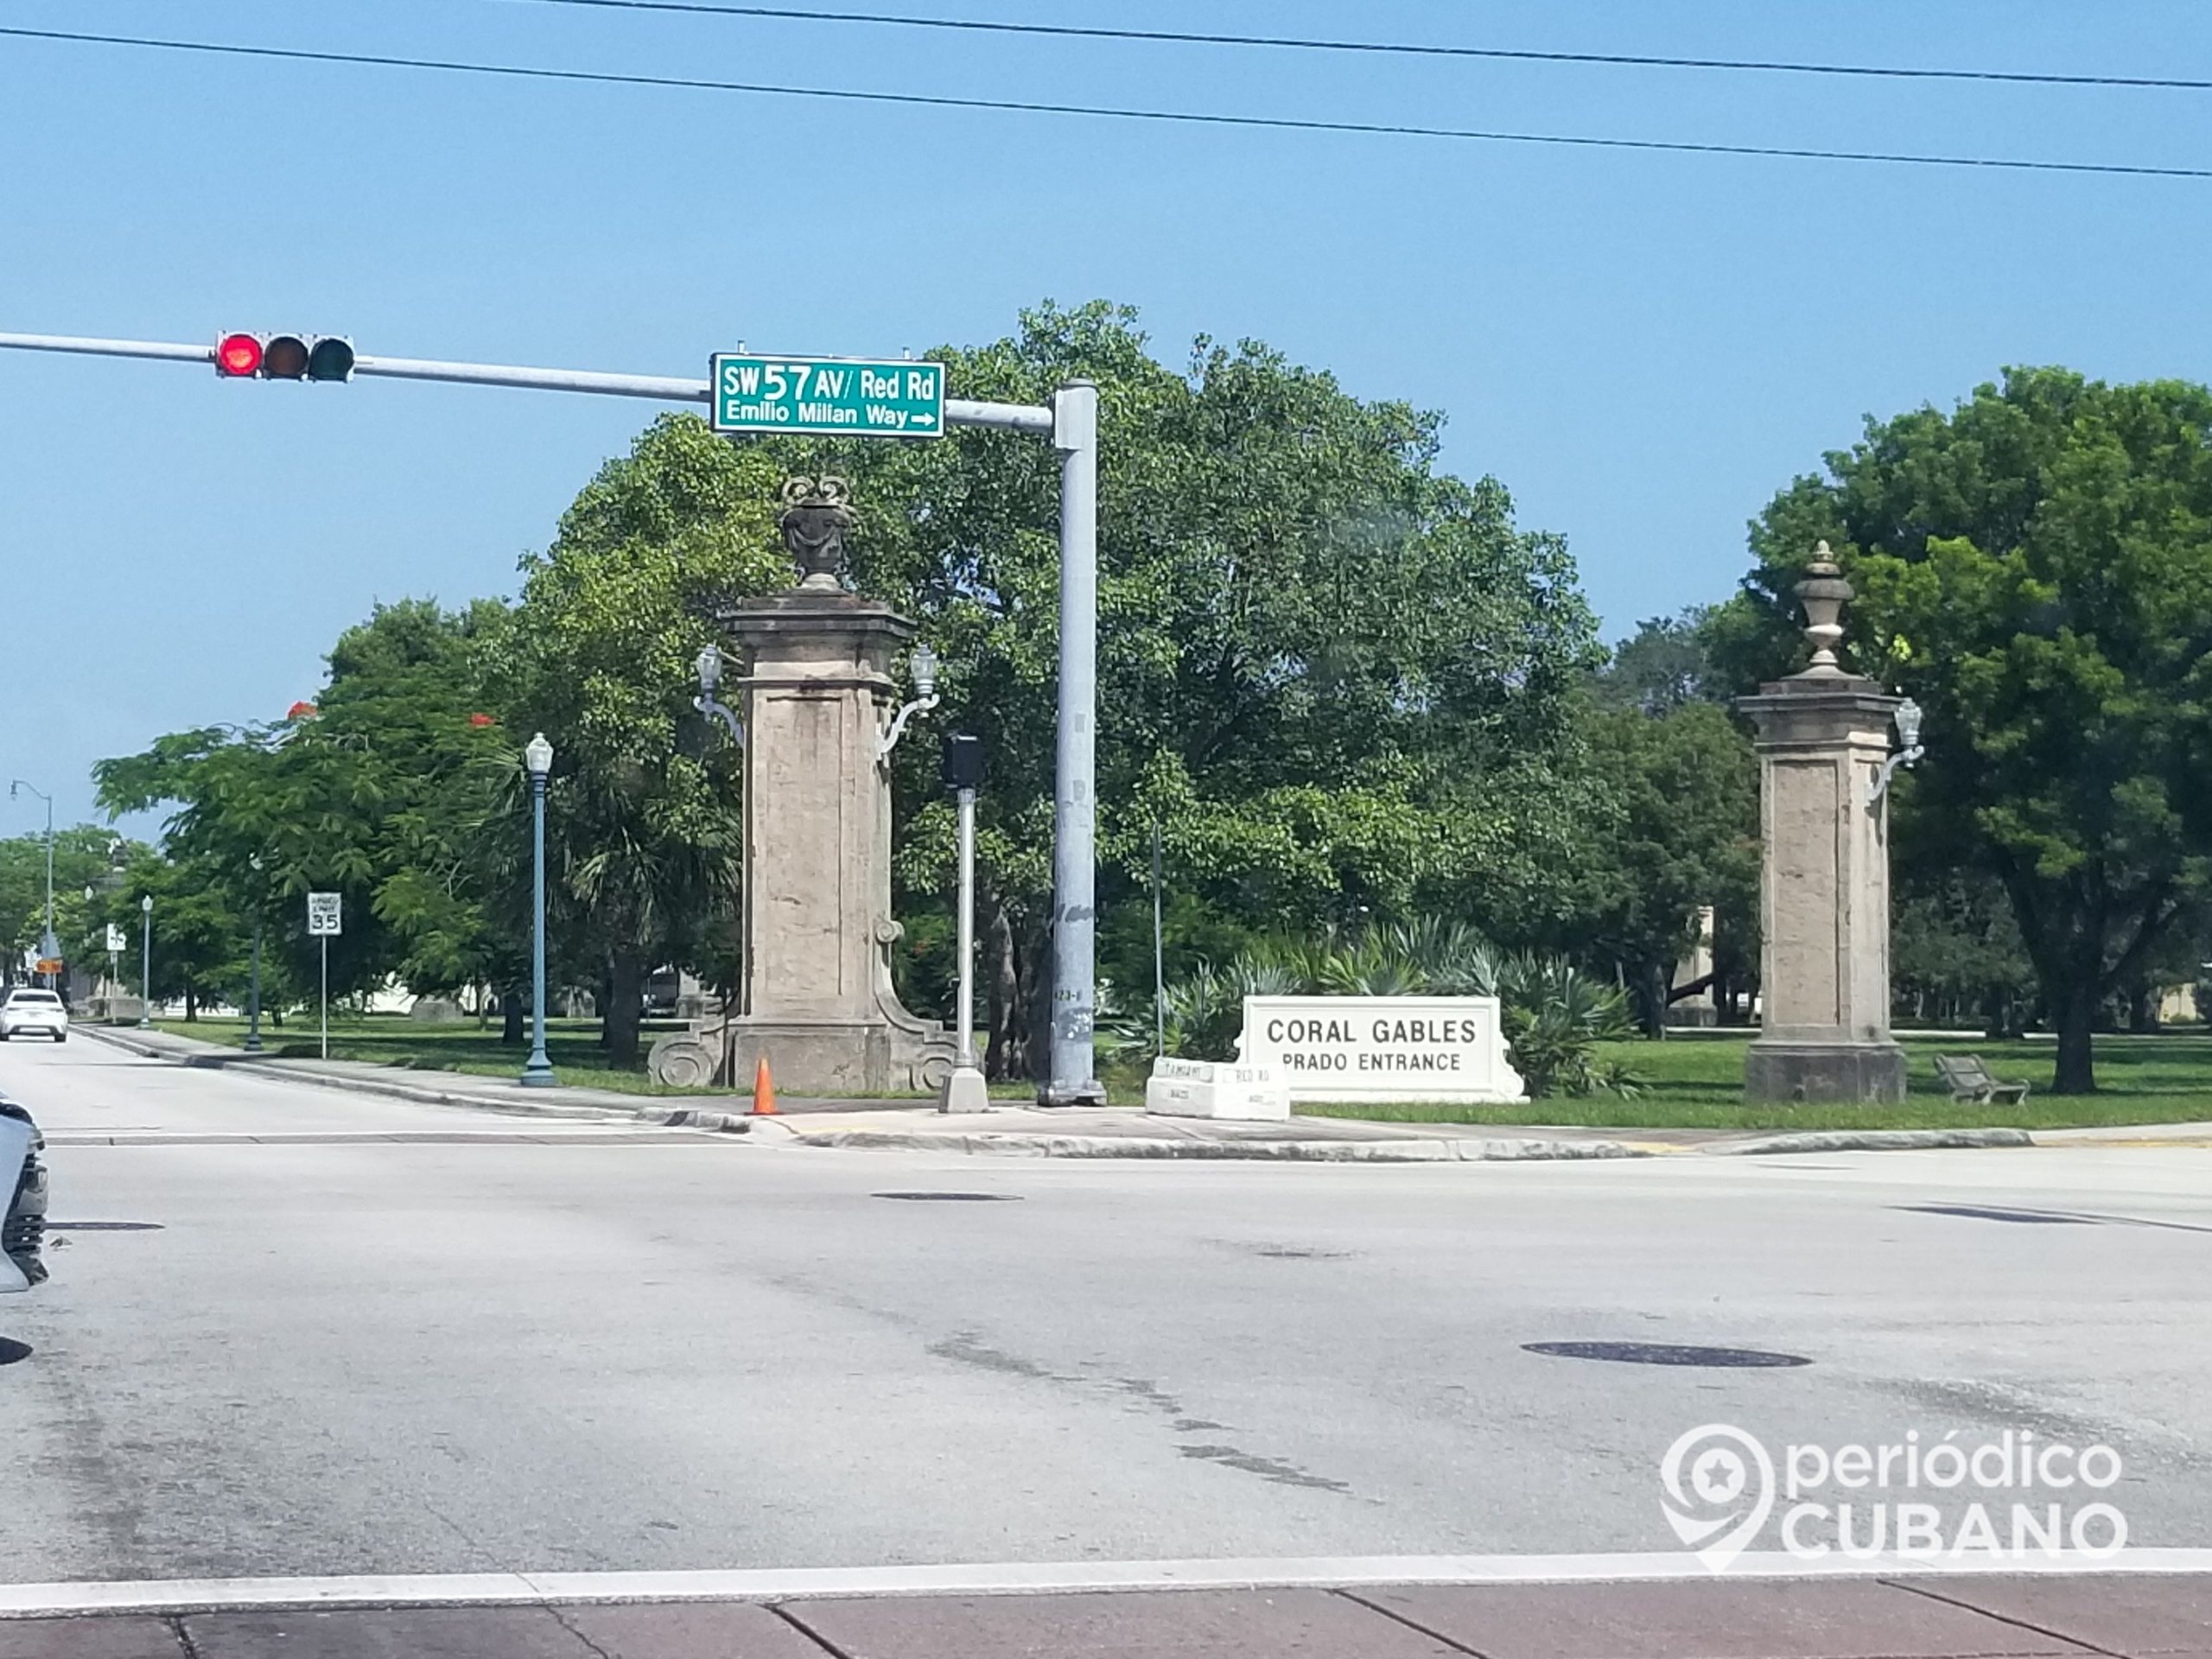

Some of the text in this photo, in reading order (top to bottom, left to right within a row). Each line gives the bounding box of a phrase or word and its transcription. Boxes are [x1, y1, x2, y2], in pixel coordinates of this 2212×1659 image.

[724, 366, 760, 396] SW
[764, 365, 811, 401] 57
[861, 370, 899, 399] Red
[907, 372, 935, 401] Rd
[726, 400, 908, 429] Emilio Milian Way
[312, 914, 338, 930] 35
[1267, 1019, 1477, 1044] CORAL GABLES
[1282, 1053, 1461, 1071] PRADO ENTRANCE
